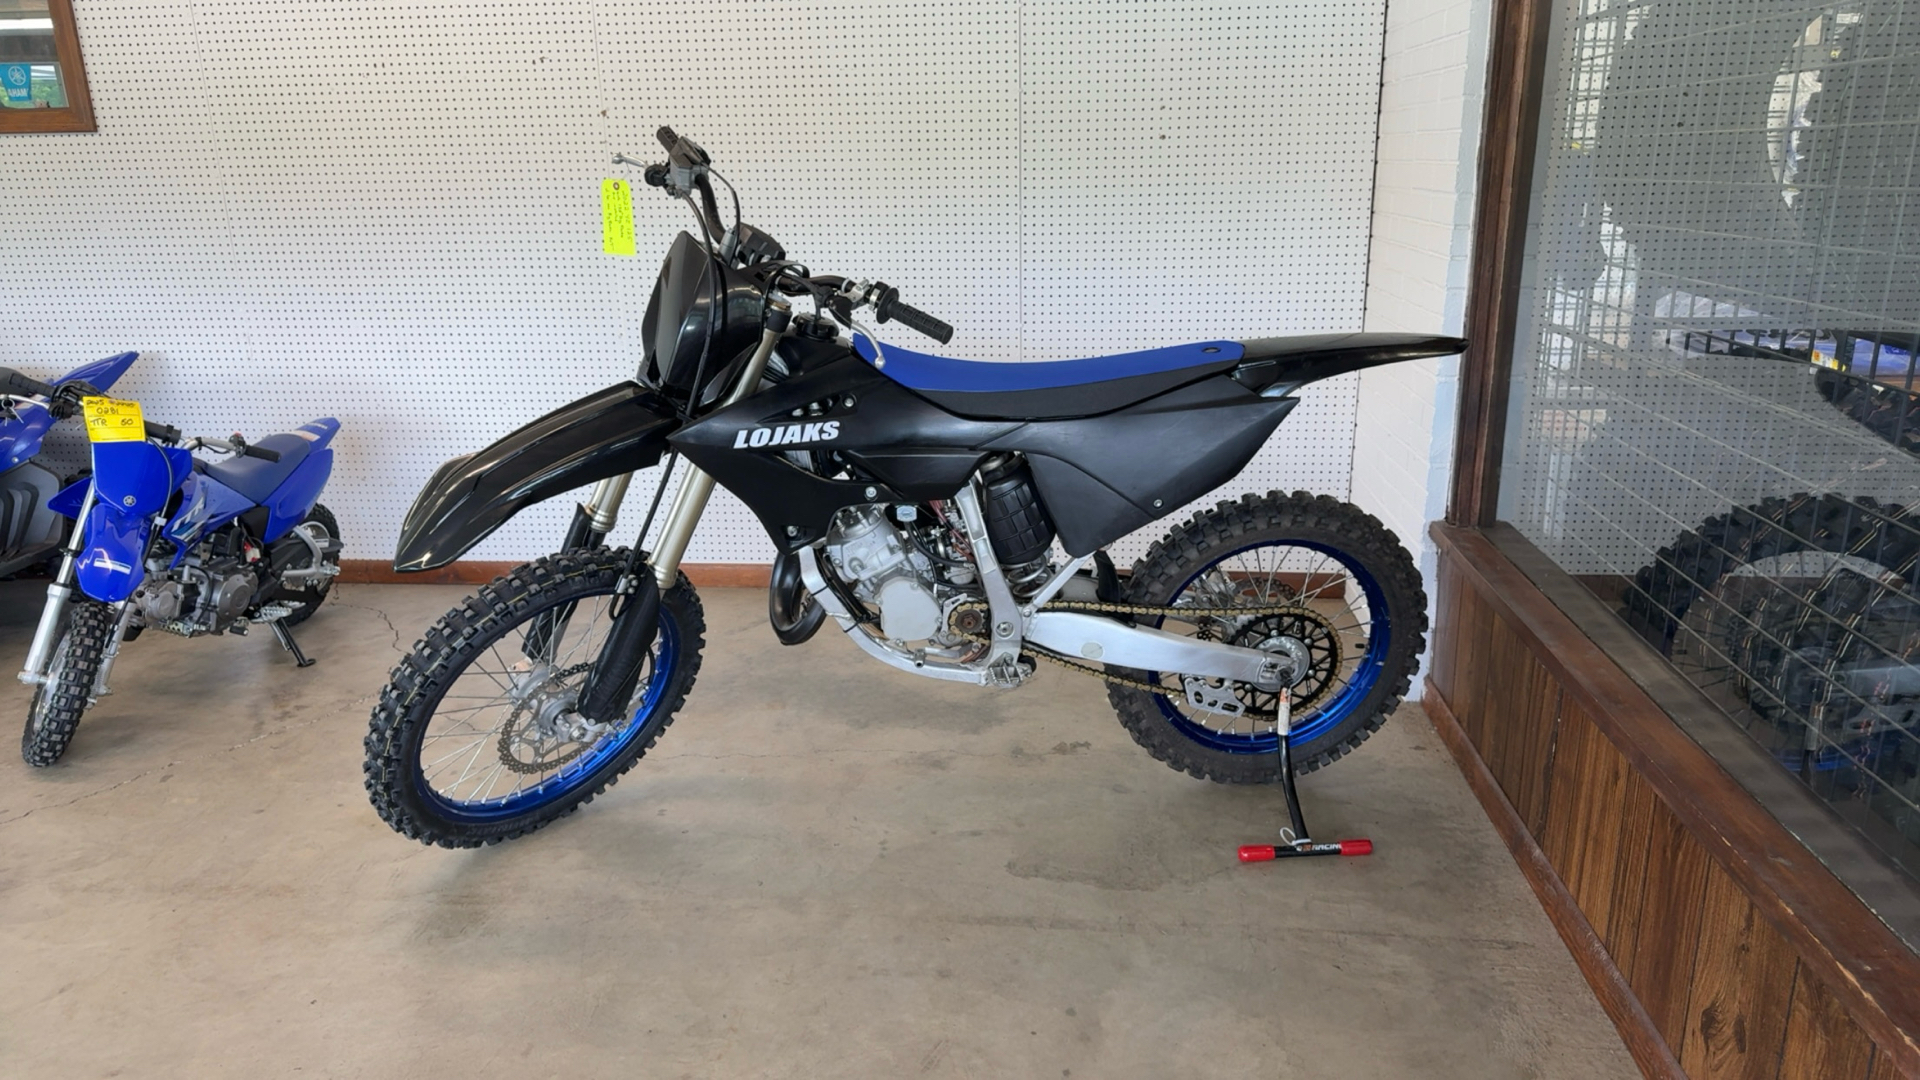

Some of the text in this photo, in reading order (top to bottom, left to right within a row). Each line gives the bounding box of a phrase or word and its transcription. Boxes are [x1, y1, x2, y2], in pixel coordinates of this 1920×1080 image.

[121, 418, 134, 426] 50
[733, 421, 840, 449] LOJAKS
[1311, 843, 1342, 851] RACIN
